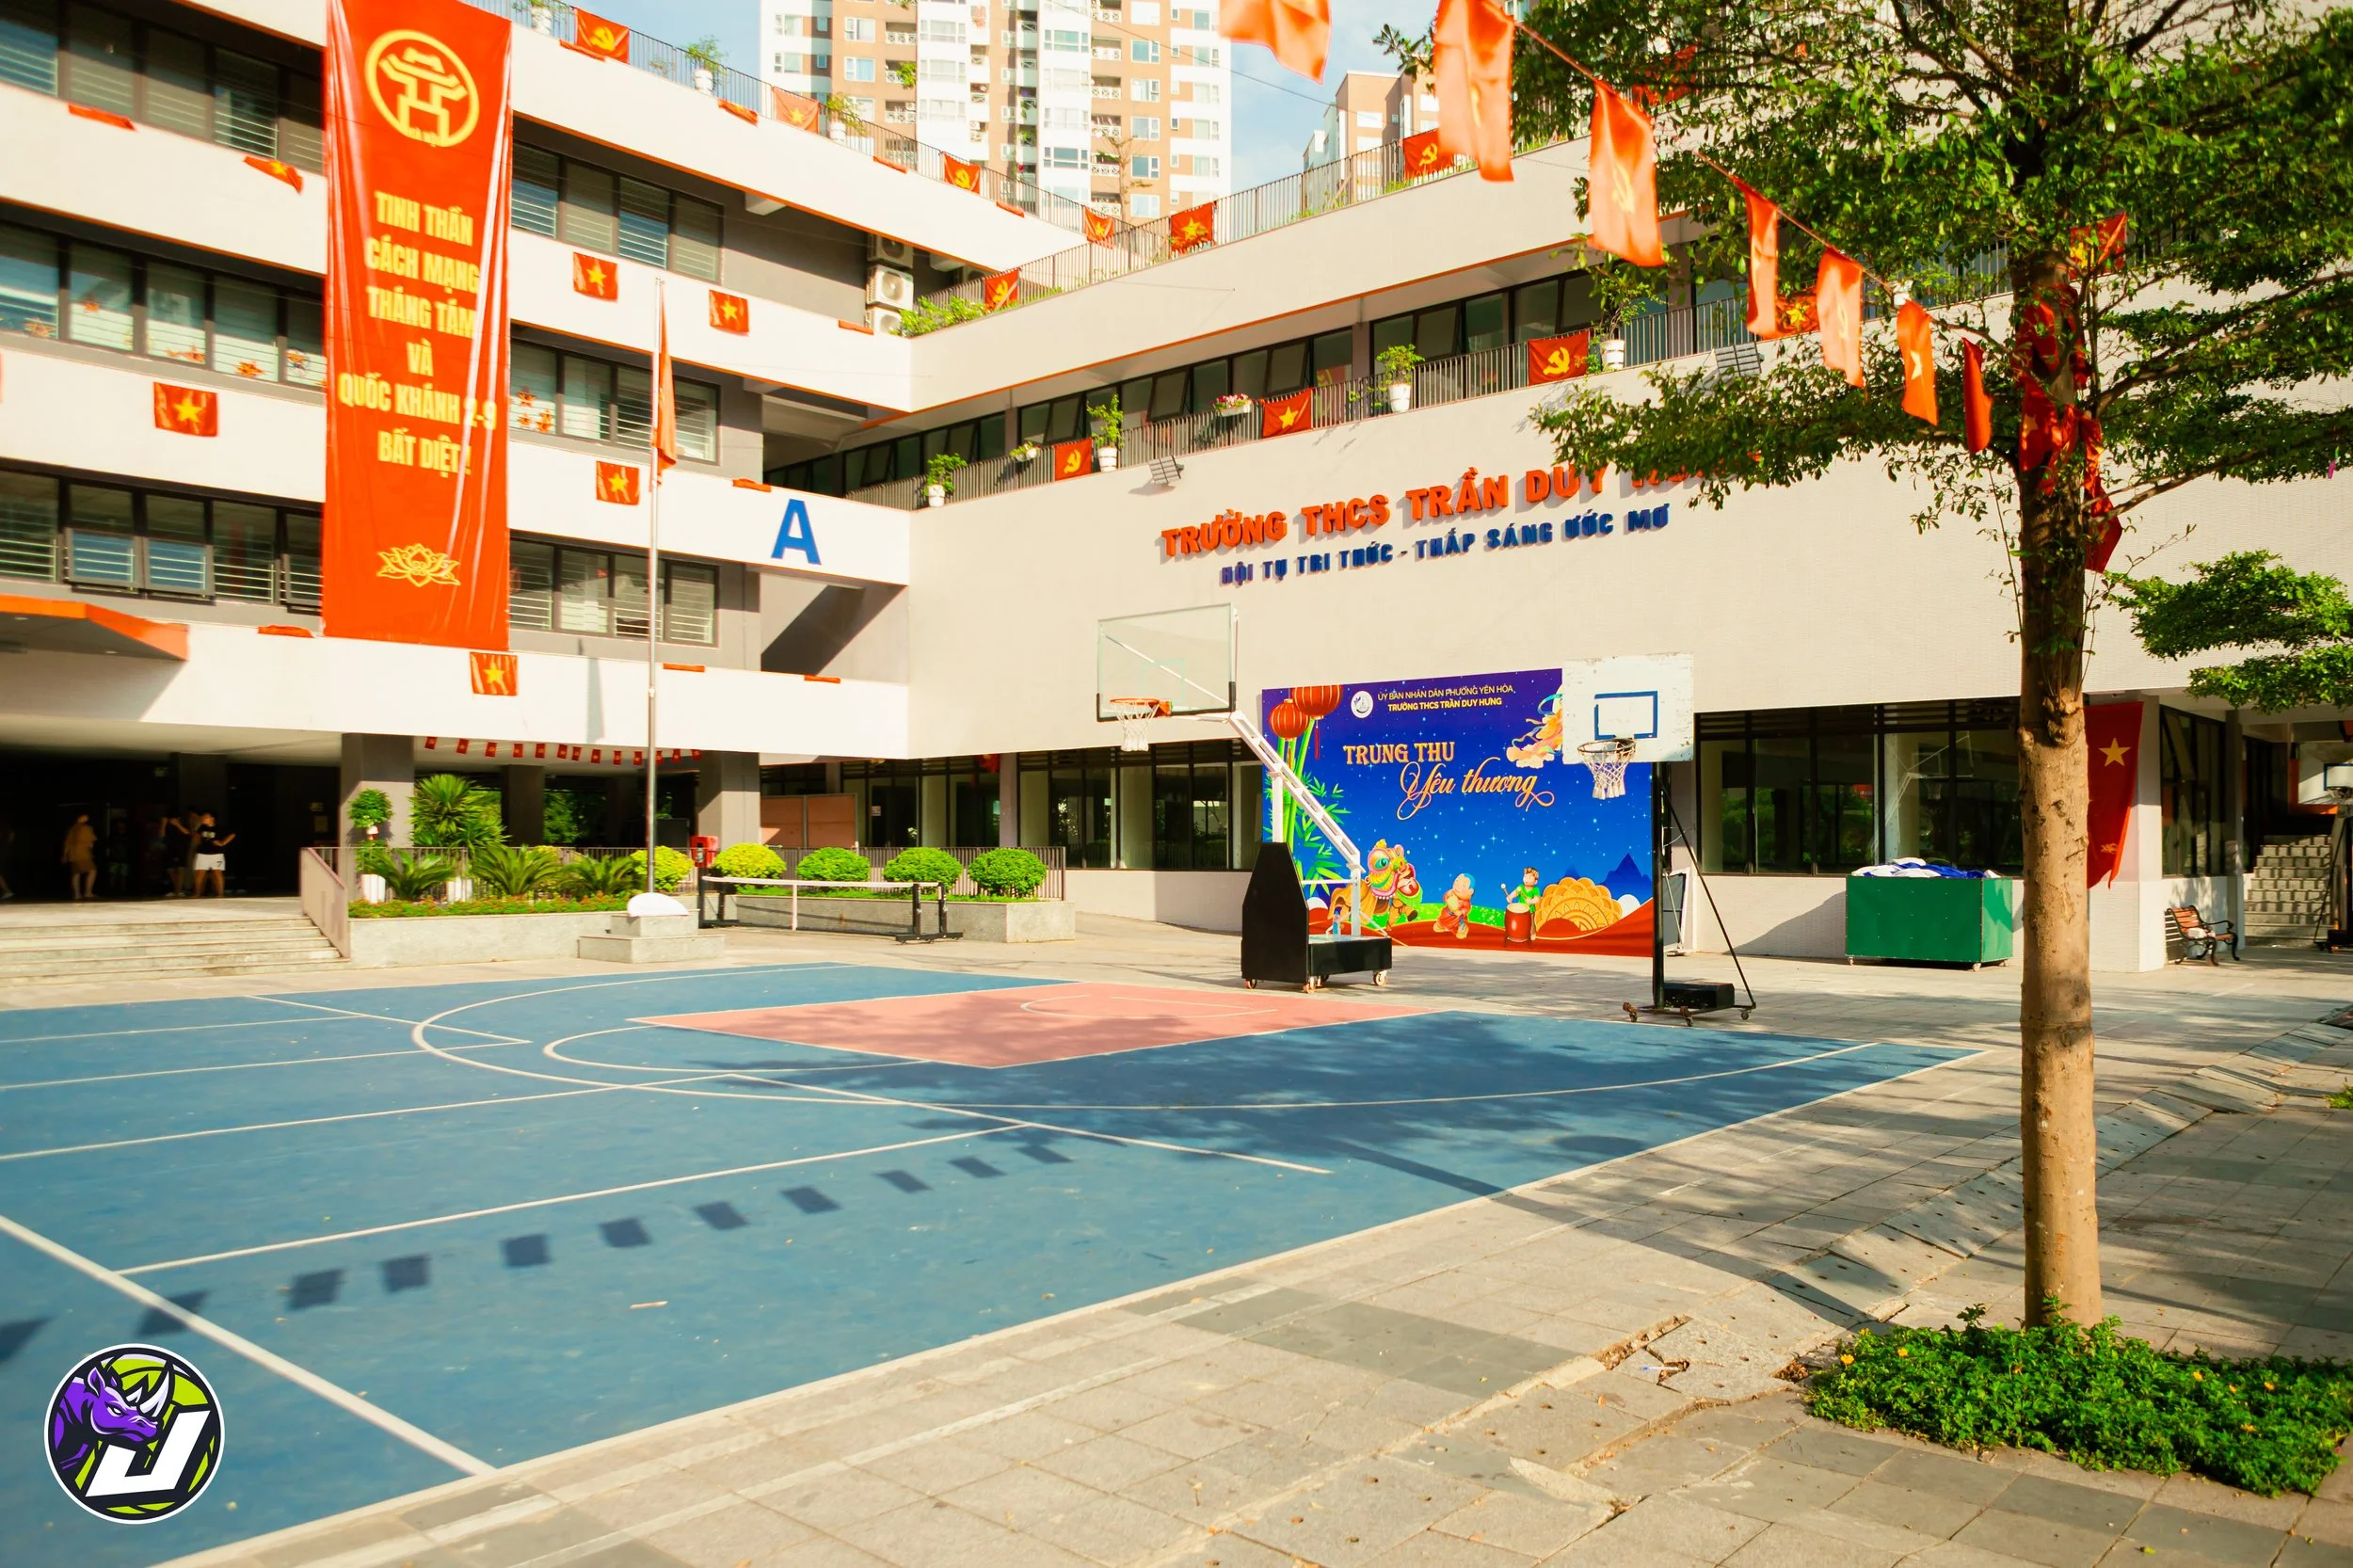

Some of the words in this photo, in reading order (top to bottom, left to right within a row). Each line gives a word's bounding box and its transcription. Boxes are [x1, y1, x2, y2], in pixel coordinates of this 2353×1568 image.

[375, 190, 420, 232] TINH
[423, 204, 473, 247] THẦN
[365, 234, 420, 280] CÁCH
[424, 251, 480, 295] MẠNG
[366, 286, 432, 329] THÁNG
[435, 298, 476, 339] TÁM
[407, 338, 434, 376] VÀ
[338, 372, 392, 411] QUỐC
[394, 382, 460, 424] KHÁNH
[464, 397, 497, 430] 2-9
[377, 427, 417, 466] BẤT
[771, 499, 822, 565] A
[1161, 509, 1288, 556] TRƯỜNG
[1301, 494, 1390, 536] THCS
[1405, 467, 1509, 520] TRẦN
[1526, 461, 1610, 503] DUY
[1221, 561, 1253, 586] HỘI
[1263, 559, 1288, 580] TỤ
[1297, 553, 1331, 573] TRI
[1339, 541, 1394, 568] THỨC
[1487, 522, 1553, 549] SÁNG
[1565, 508, 1614, 539] ƯỚC
[1627, 503, 1670, 532] MƠ
[1388, 700, 1418, 712] TRƯỜNG
[1419, 701, 1439, 710] THCS
[1440, 697, 1460, 709] TRẦN
[1462, 698, 1478, 707] DUY
[1479, 696, 1502, 706] HƯNG
[1389, 692, 1404, 700] BAN
[1405, 689, 1427, 698] NHÂN
[1428, 688, 1444, 697] DÂN
[1445, 685, 1478, 696] PHƯỜNG
[1479, 684, 1495, 695] YÊN
[1343, 744, 1409, 765] TRUNG
[1414, 742, 1455, 761] THU
[1397, 761, 1456, 821] Yêu
[1462, 756, 1555, 812] thương
